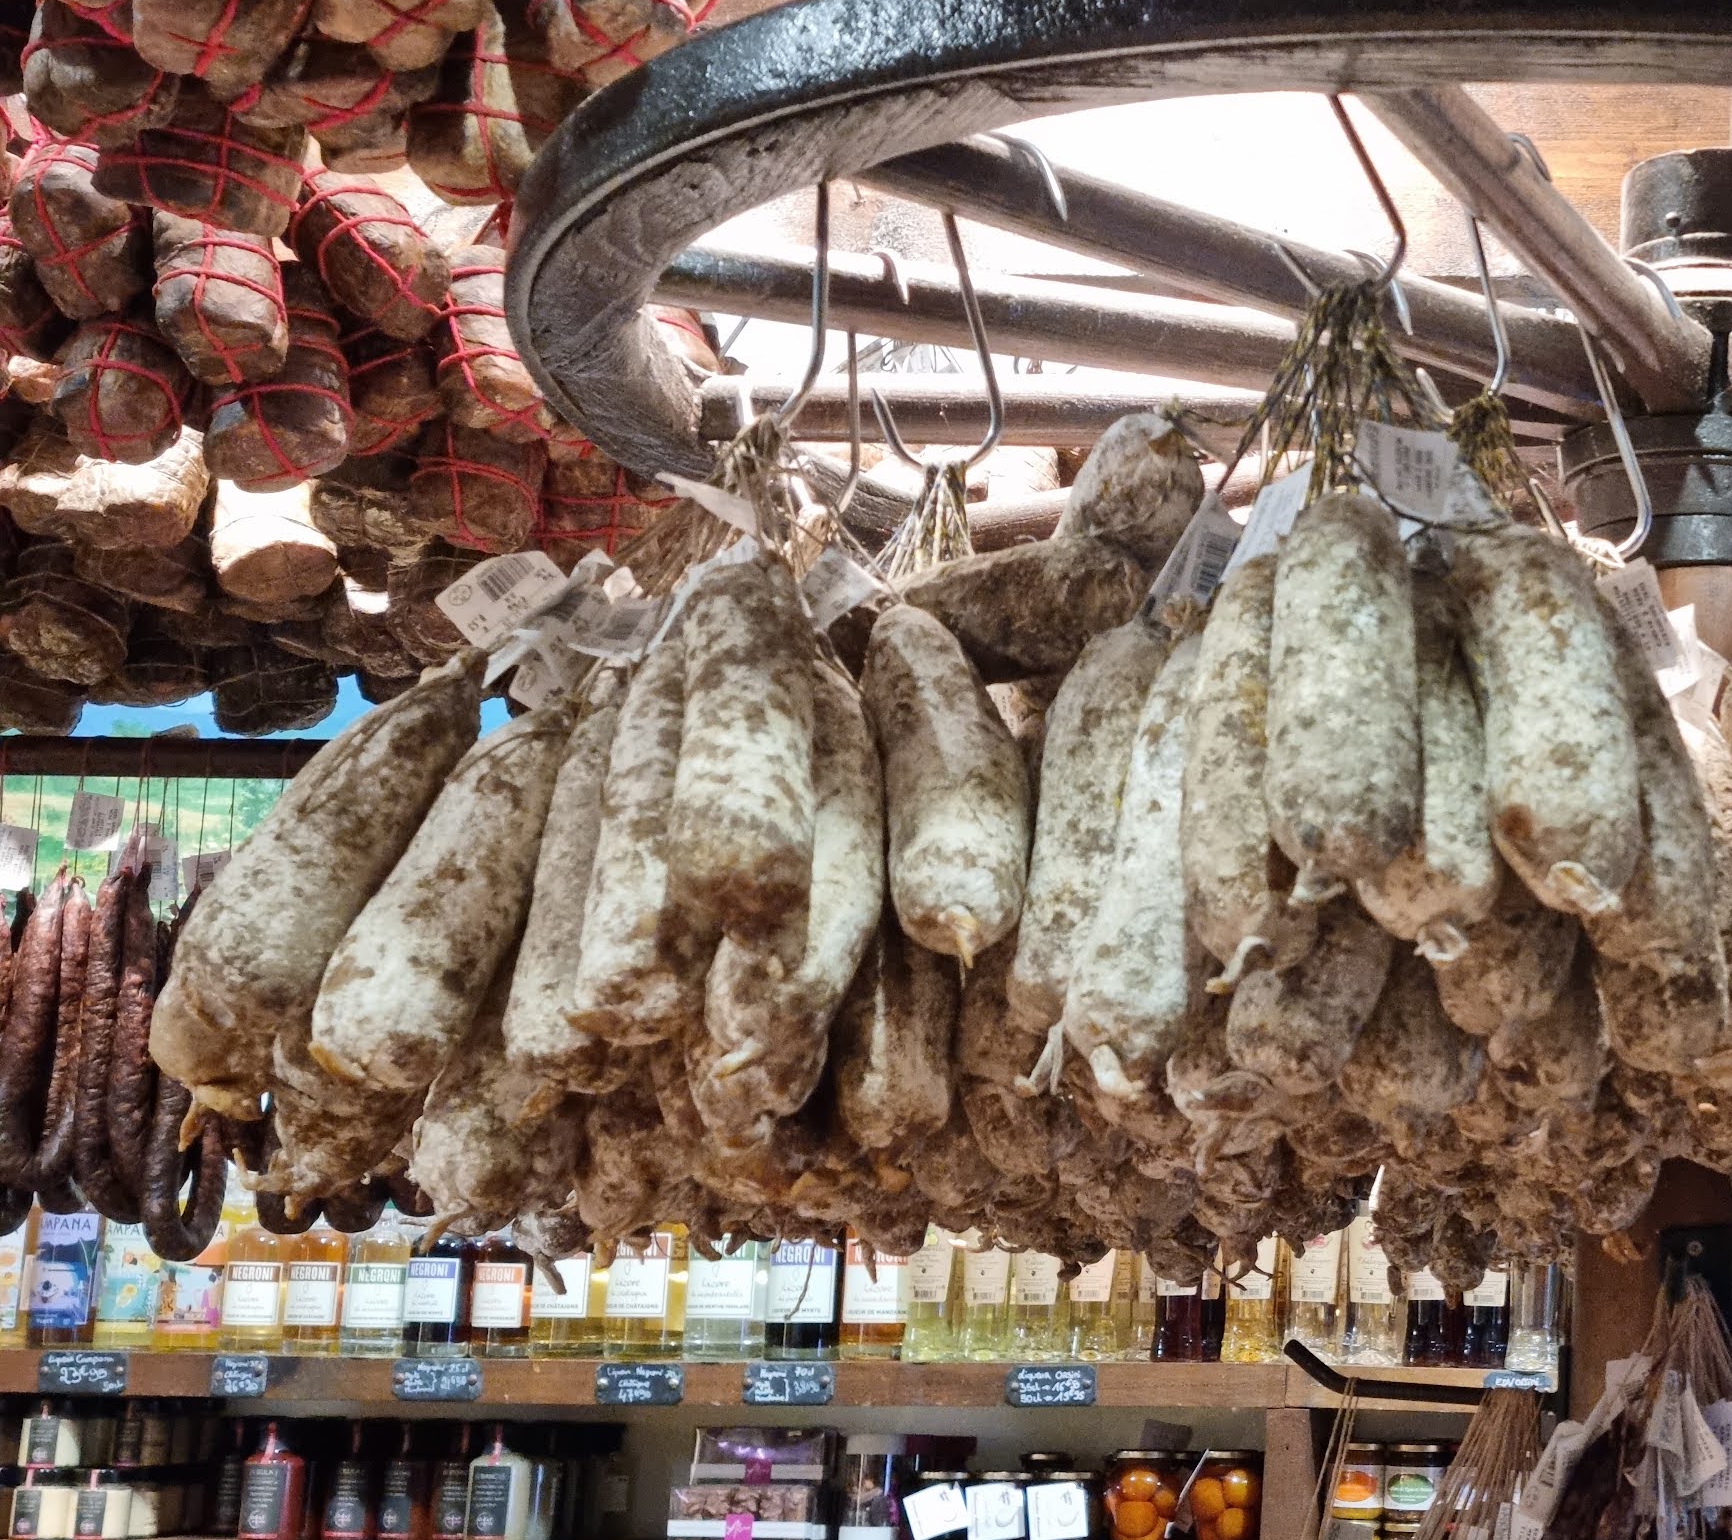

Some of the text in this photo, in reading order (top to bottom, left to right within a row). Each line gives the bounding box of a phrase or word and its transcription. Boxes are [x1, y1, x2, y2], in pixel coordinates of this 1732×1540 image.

[232, 1266, 273, 1281] NEGRONI
[290, 1266, 330, 1281] NEGRONI
[410, 1260, 449, 1276] NEGRONI
[479, 1268, 515, 1282] NEGRONI
[358, 1268, 400, 1284] NEGRONI
